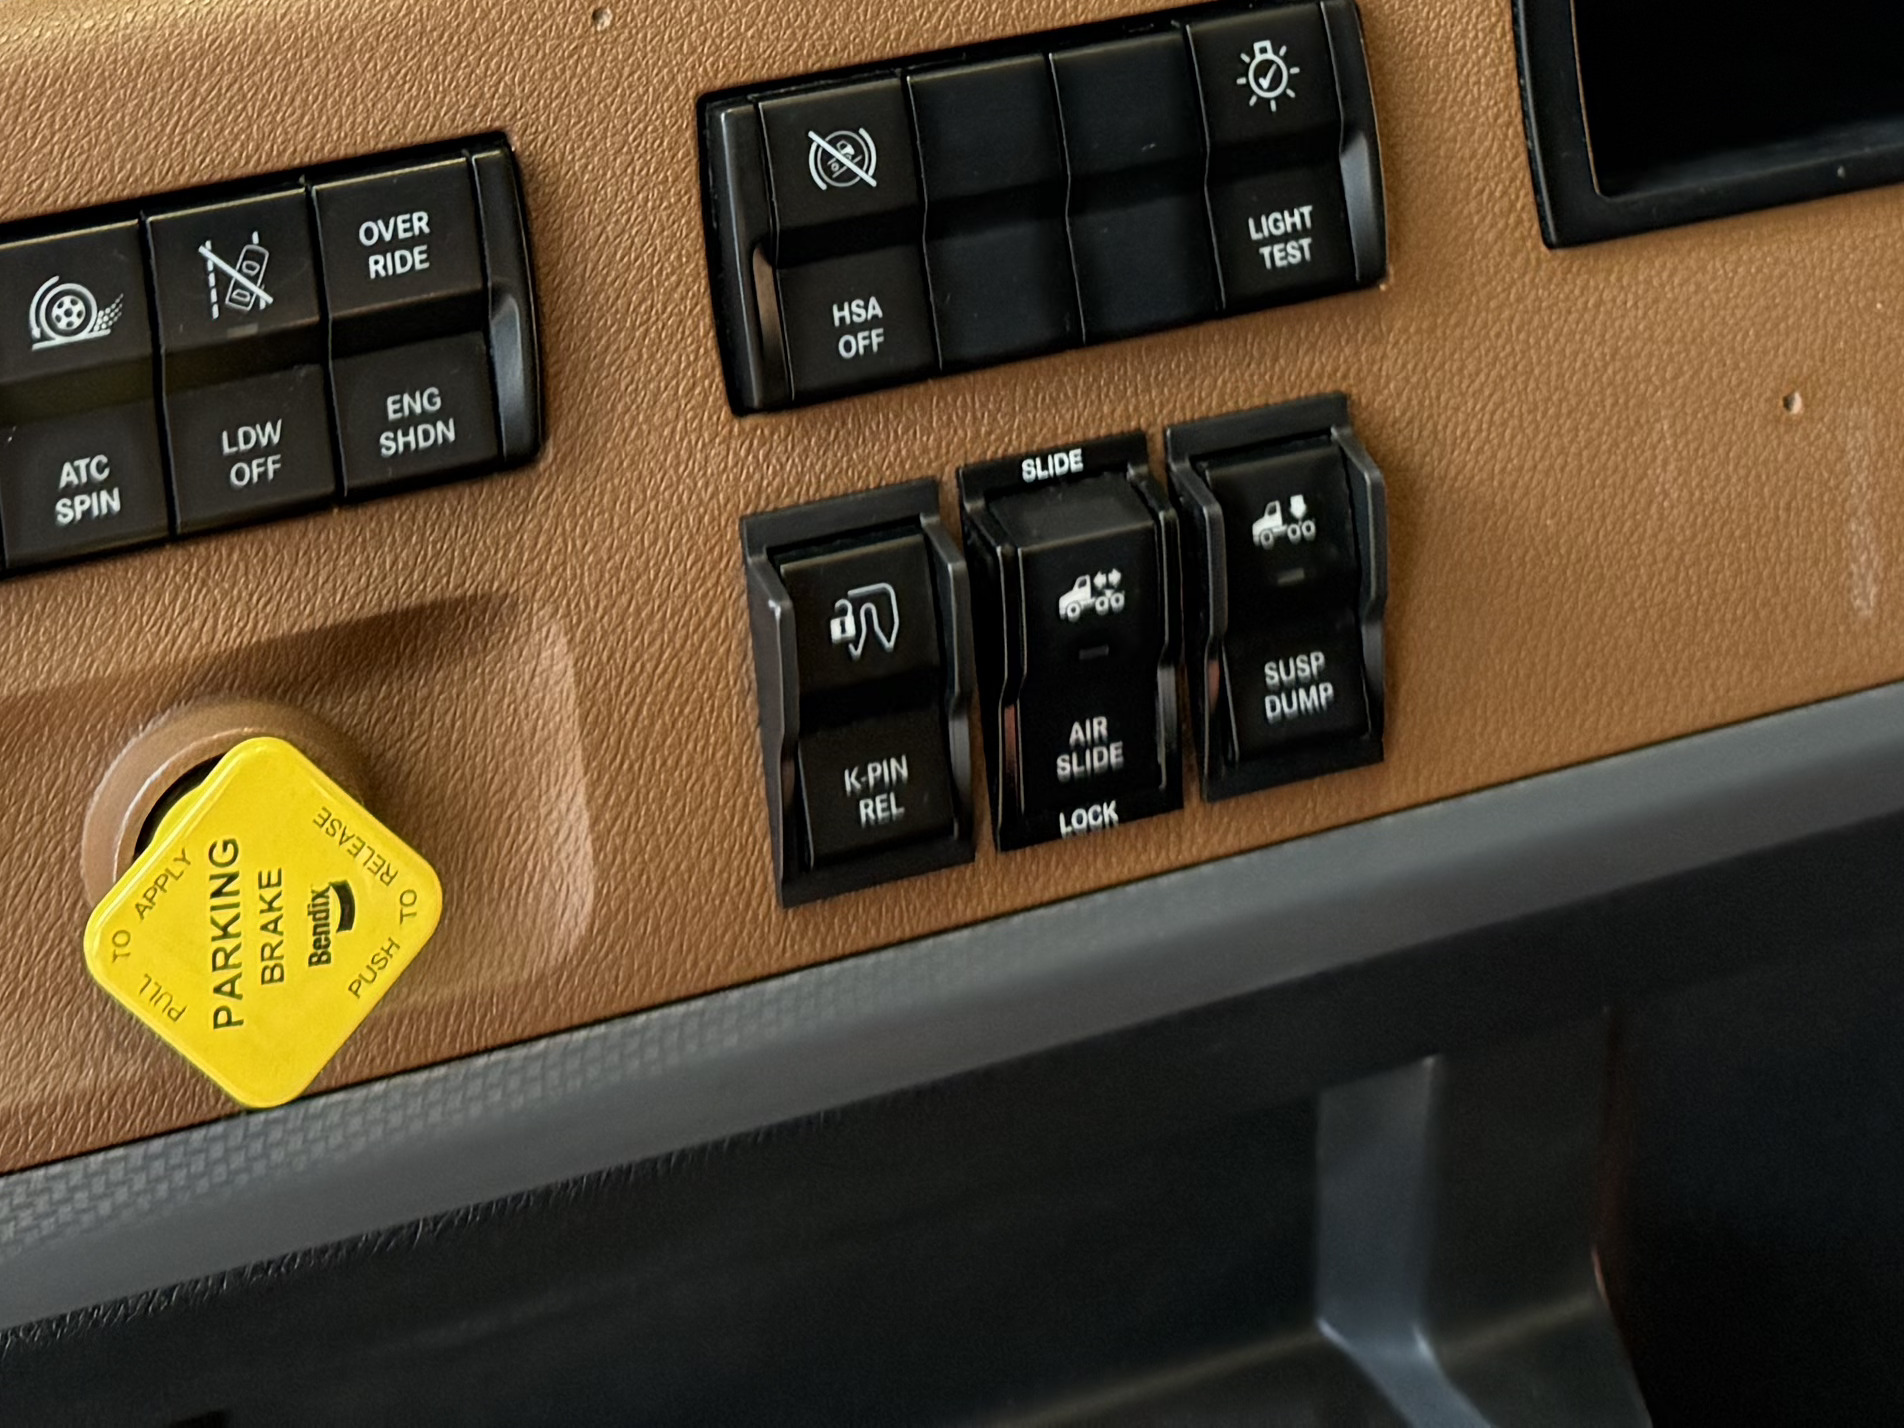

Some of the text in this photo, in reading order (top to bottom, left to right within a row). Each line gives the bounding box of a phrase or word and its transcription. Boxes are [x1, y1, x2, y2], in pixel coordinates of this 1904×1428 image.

[358, 211, 431, 250] OVER
[1248, 204, 1314, 242] LIGHT
[367, 246, 431, 281] RIDE
[1258, 237, 1313, 271] TEST
[832, 295, 884, 327] HSA
[837, 328, 885, 360] OFF
[385, 387, 442, 421] ENG
[221, 420, 284, 457] LDW
[379, 418, 456, 458] SHDN
[58, 455, 111, 491] ATC
[229, 455, 283, 489] OFF
[1021, 448, 1084, 483] SLIDE
[54, 488, 122, 527] SPIN
[1263, 651, 1326, 687] SUSP
[1263, 681, 1335, 723] DUMP
[1068, 715, 1109, 745] AIR
[844, 755, 909, 795] K-PIN
[1055, 741, 1125, 782] SLIDE
[858, 792, 906, 827] REL
[1058, 800, 1120, 838] LOCK
[312, 806, 418, 1000] PUSH TO RELEASE
[111, 847, 193, 1024] PULL TO APPLY
[207, 837, 245, 1030] PARKING
[257, 867, 285, 986] BRAKE
[307, 884, 333, 968] Bendix
